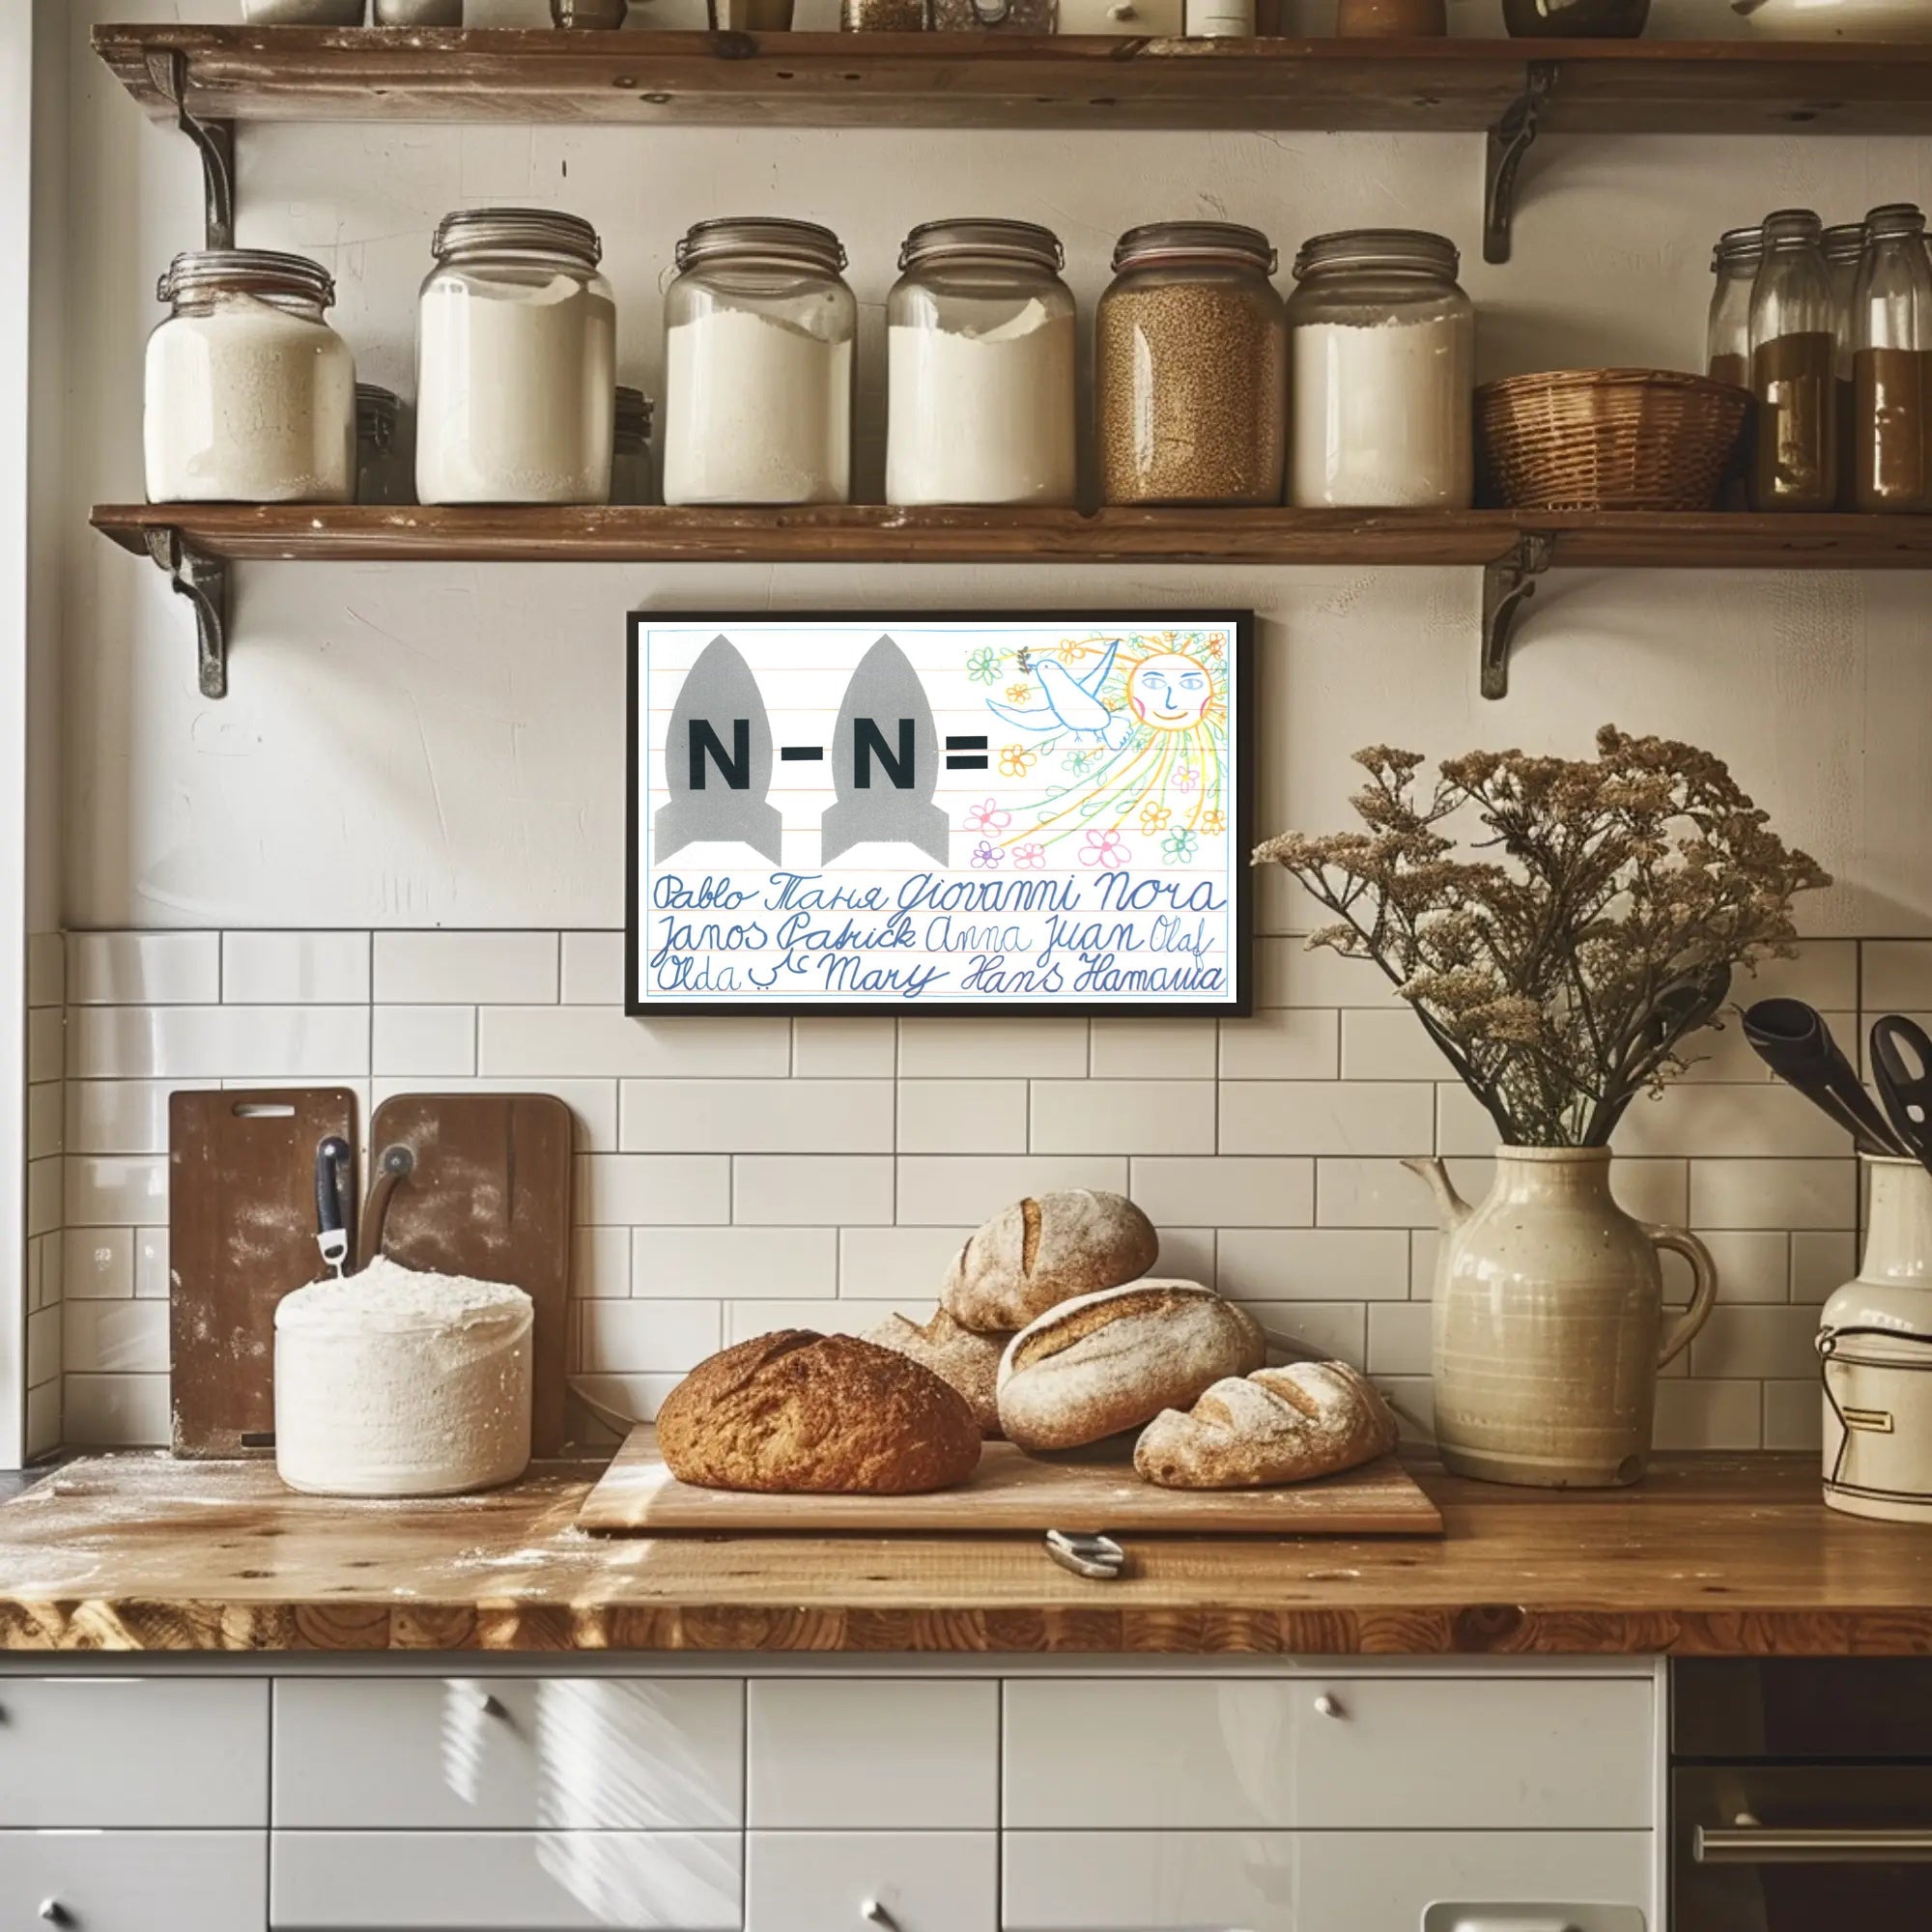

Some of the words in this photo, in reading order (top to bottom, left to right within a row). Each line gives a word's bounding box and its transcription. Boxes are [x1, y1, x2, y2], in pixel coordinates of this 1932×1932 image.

[688, 719, 751, 790] N
[854, 718, 915, 790] N
[654, 874, 759, 910] Pablo
[764, 871, 890, 911] Таня
[887, 872, 1081, 928] Giovanni
[1093, 871, 1227, 912] Nora
[650, 915, 768, 968] Janos
[777, 911, 916, 951] Patrick
[925, 915, 1033, 952] Anna
[1037, 914, 1146, 969] Juan
[1149, 914, 1215, 973] Olaf
[657, 954, 742, 991] Olda
[816, 952, 952, 999] Mary
[961, 953, 1064, 994] Hans
